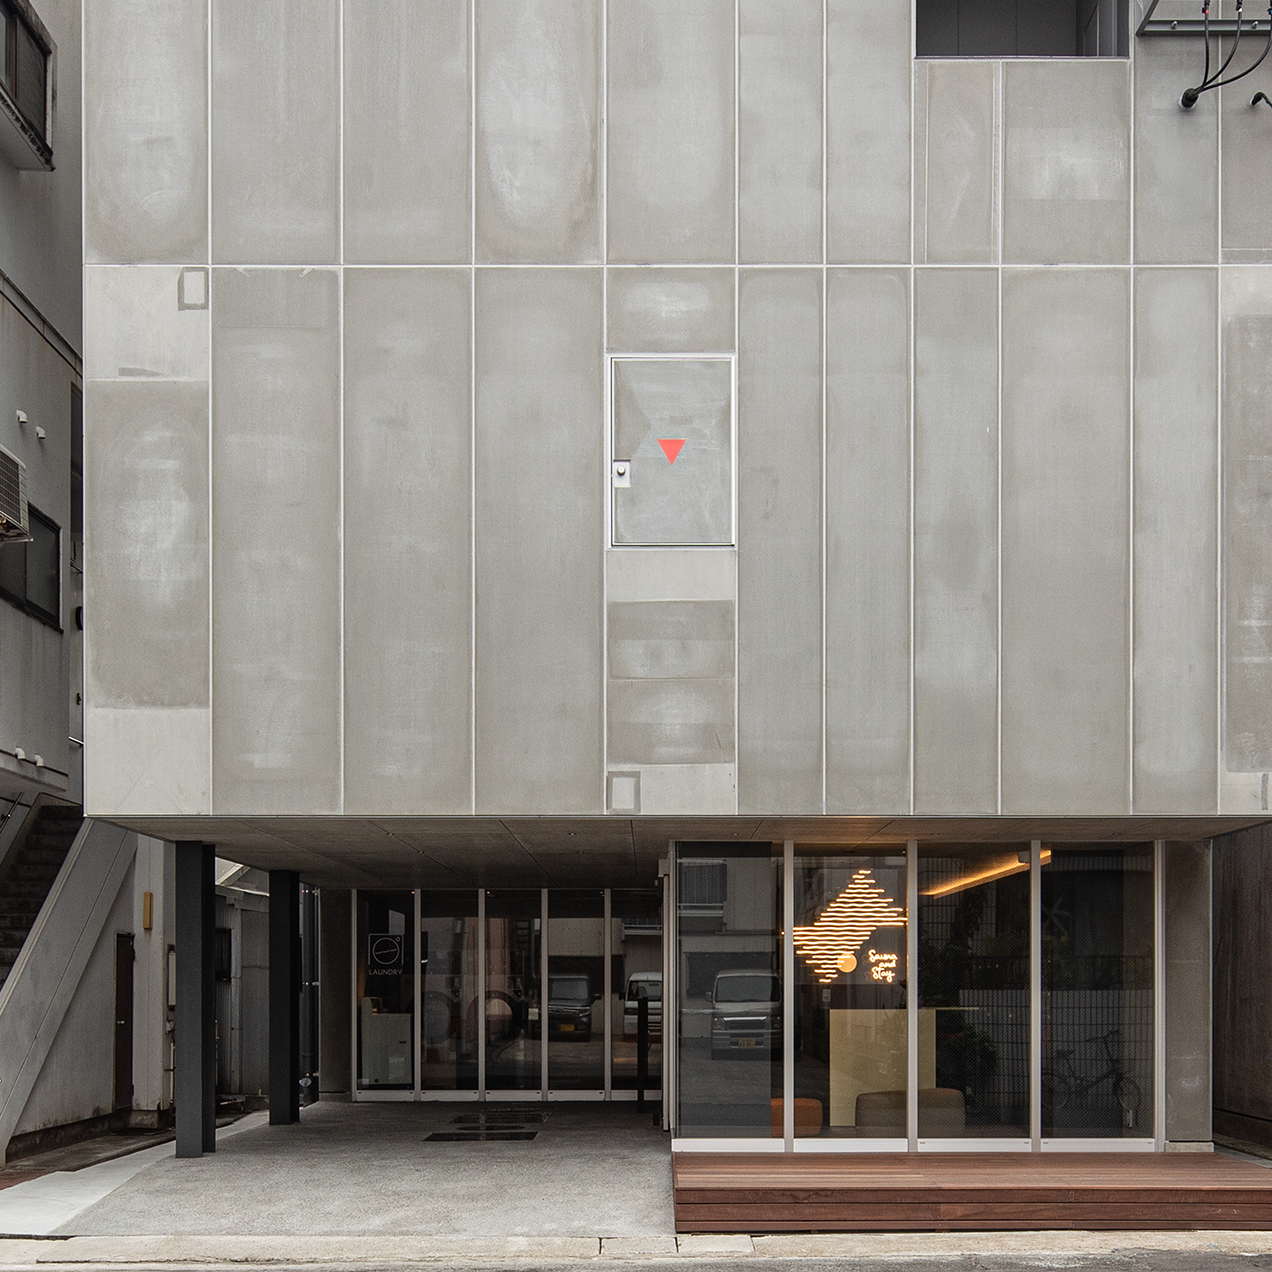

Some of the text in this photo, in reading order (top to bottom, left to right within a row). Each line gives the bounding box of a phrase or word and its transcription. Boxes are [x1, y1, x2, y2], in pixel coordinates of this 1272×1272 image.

[868, 949, 898, 963] Sauna
[878, 959, 897, 968] and
[368, 968, 403, 976] LAUNDRY
[871, 966, 896, 983] Stay
